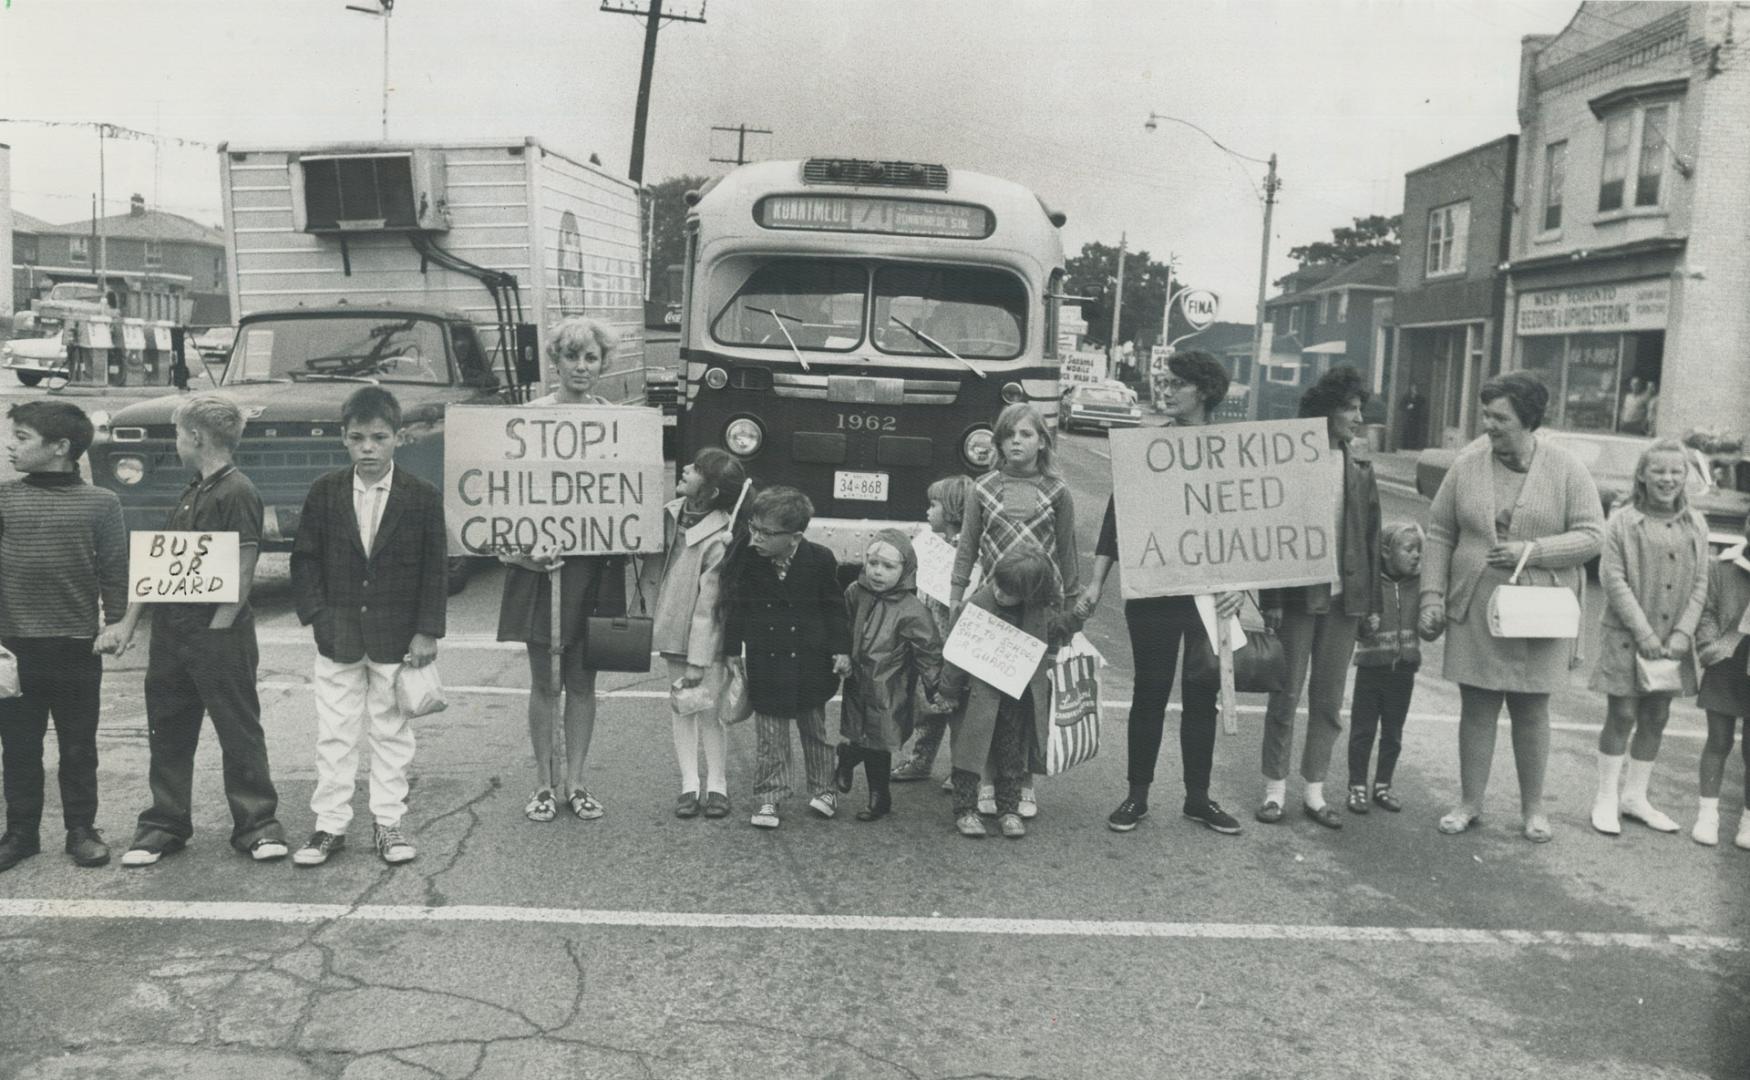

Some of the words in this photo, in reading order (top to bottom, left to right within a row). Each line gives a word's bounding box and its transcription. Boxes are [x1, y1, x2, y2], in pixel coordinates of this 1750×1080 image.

[1189, 300, 1213, 314] FINA
[1534, 293, 1560, 306] WEST
[1567, 287, 1617, 303] TORONTO
[837, 413, 897, 431] 1962
[1146, 435, 1225, 472] OUR
[1238, 430, 1320, 468] KIDS
[458, 468, 644, 507] CHILDREN
[1184, 476, 1285, 516] NEED
[150, 534, 213, 557] BUS
[461, 513, 642, 555] CROSSING
[1139, 531, 1166, 567] A
[1178, 525, 1328, 566] GUAURD
[169, 556, 202, 576] OR
[136, 576, 224, 597] GUARD
